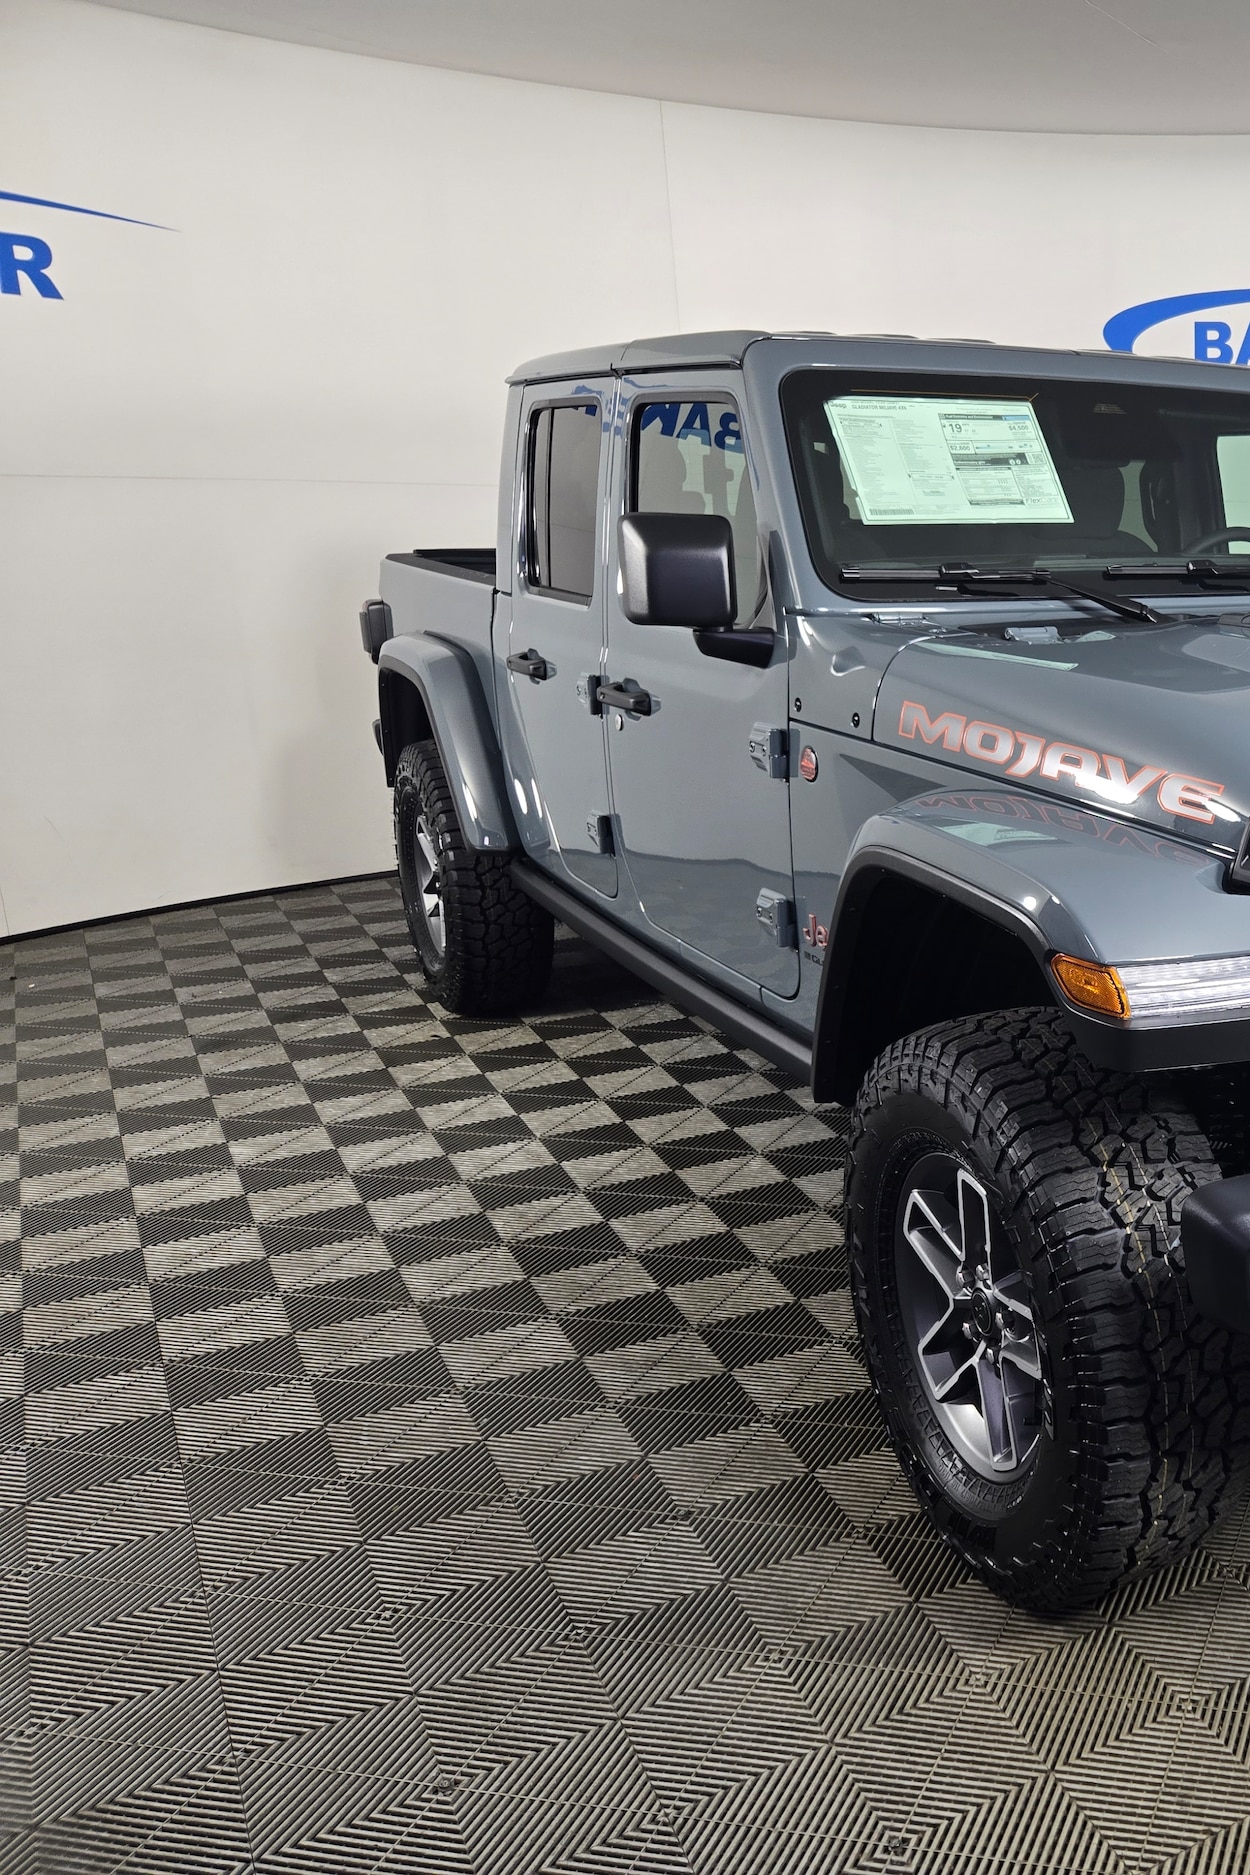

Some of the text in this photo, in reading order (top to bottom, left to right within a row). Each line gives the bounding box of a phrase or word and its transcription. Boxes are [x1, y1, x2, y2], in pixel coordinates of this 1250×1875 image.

[948, 423, 962, 433] 19
[898, 700, 1225, 825] MOJAVE
[802, 913, 829, 948] Je
